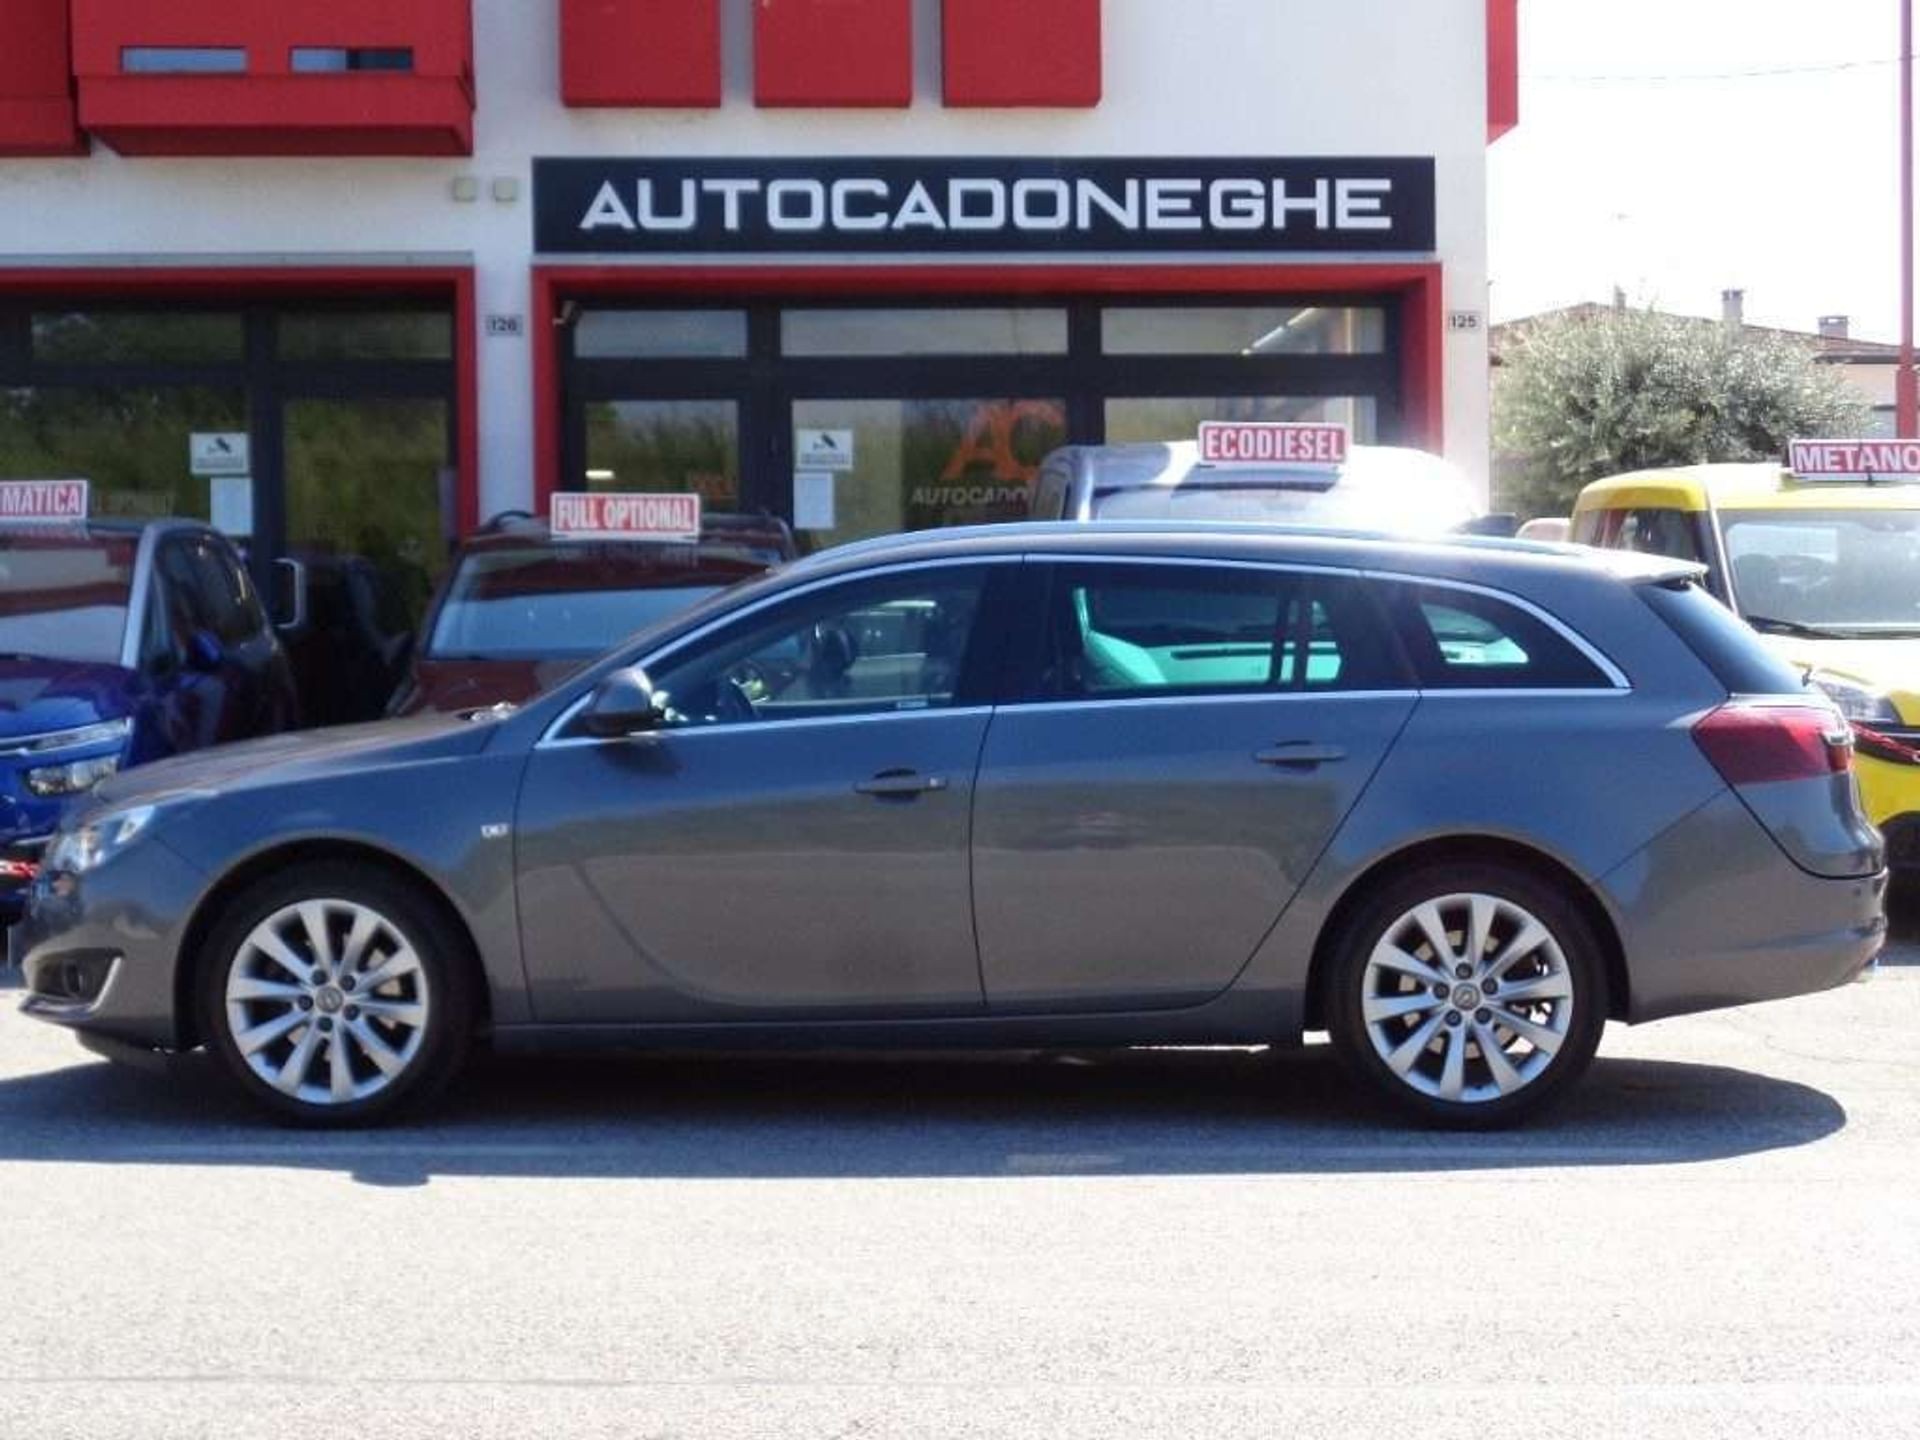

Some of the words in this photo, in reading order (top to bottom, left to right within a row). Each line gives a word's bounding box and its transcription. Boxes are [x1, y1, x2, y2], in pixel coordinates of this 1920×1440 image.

[579, 178, 1393, 231] AUTOCADONEGHE
[1452, 314, 1477, 329] 125
[1205, 428, 1341, 459] ECODIESEL
[1795, 445, 1920, 471] METANO
[2, 486, 80, 513] MATICA
[557, 499, 599, 528] FULL
[603, 499, 691, 529] OPTIONAL
